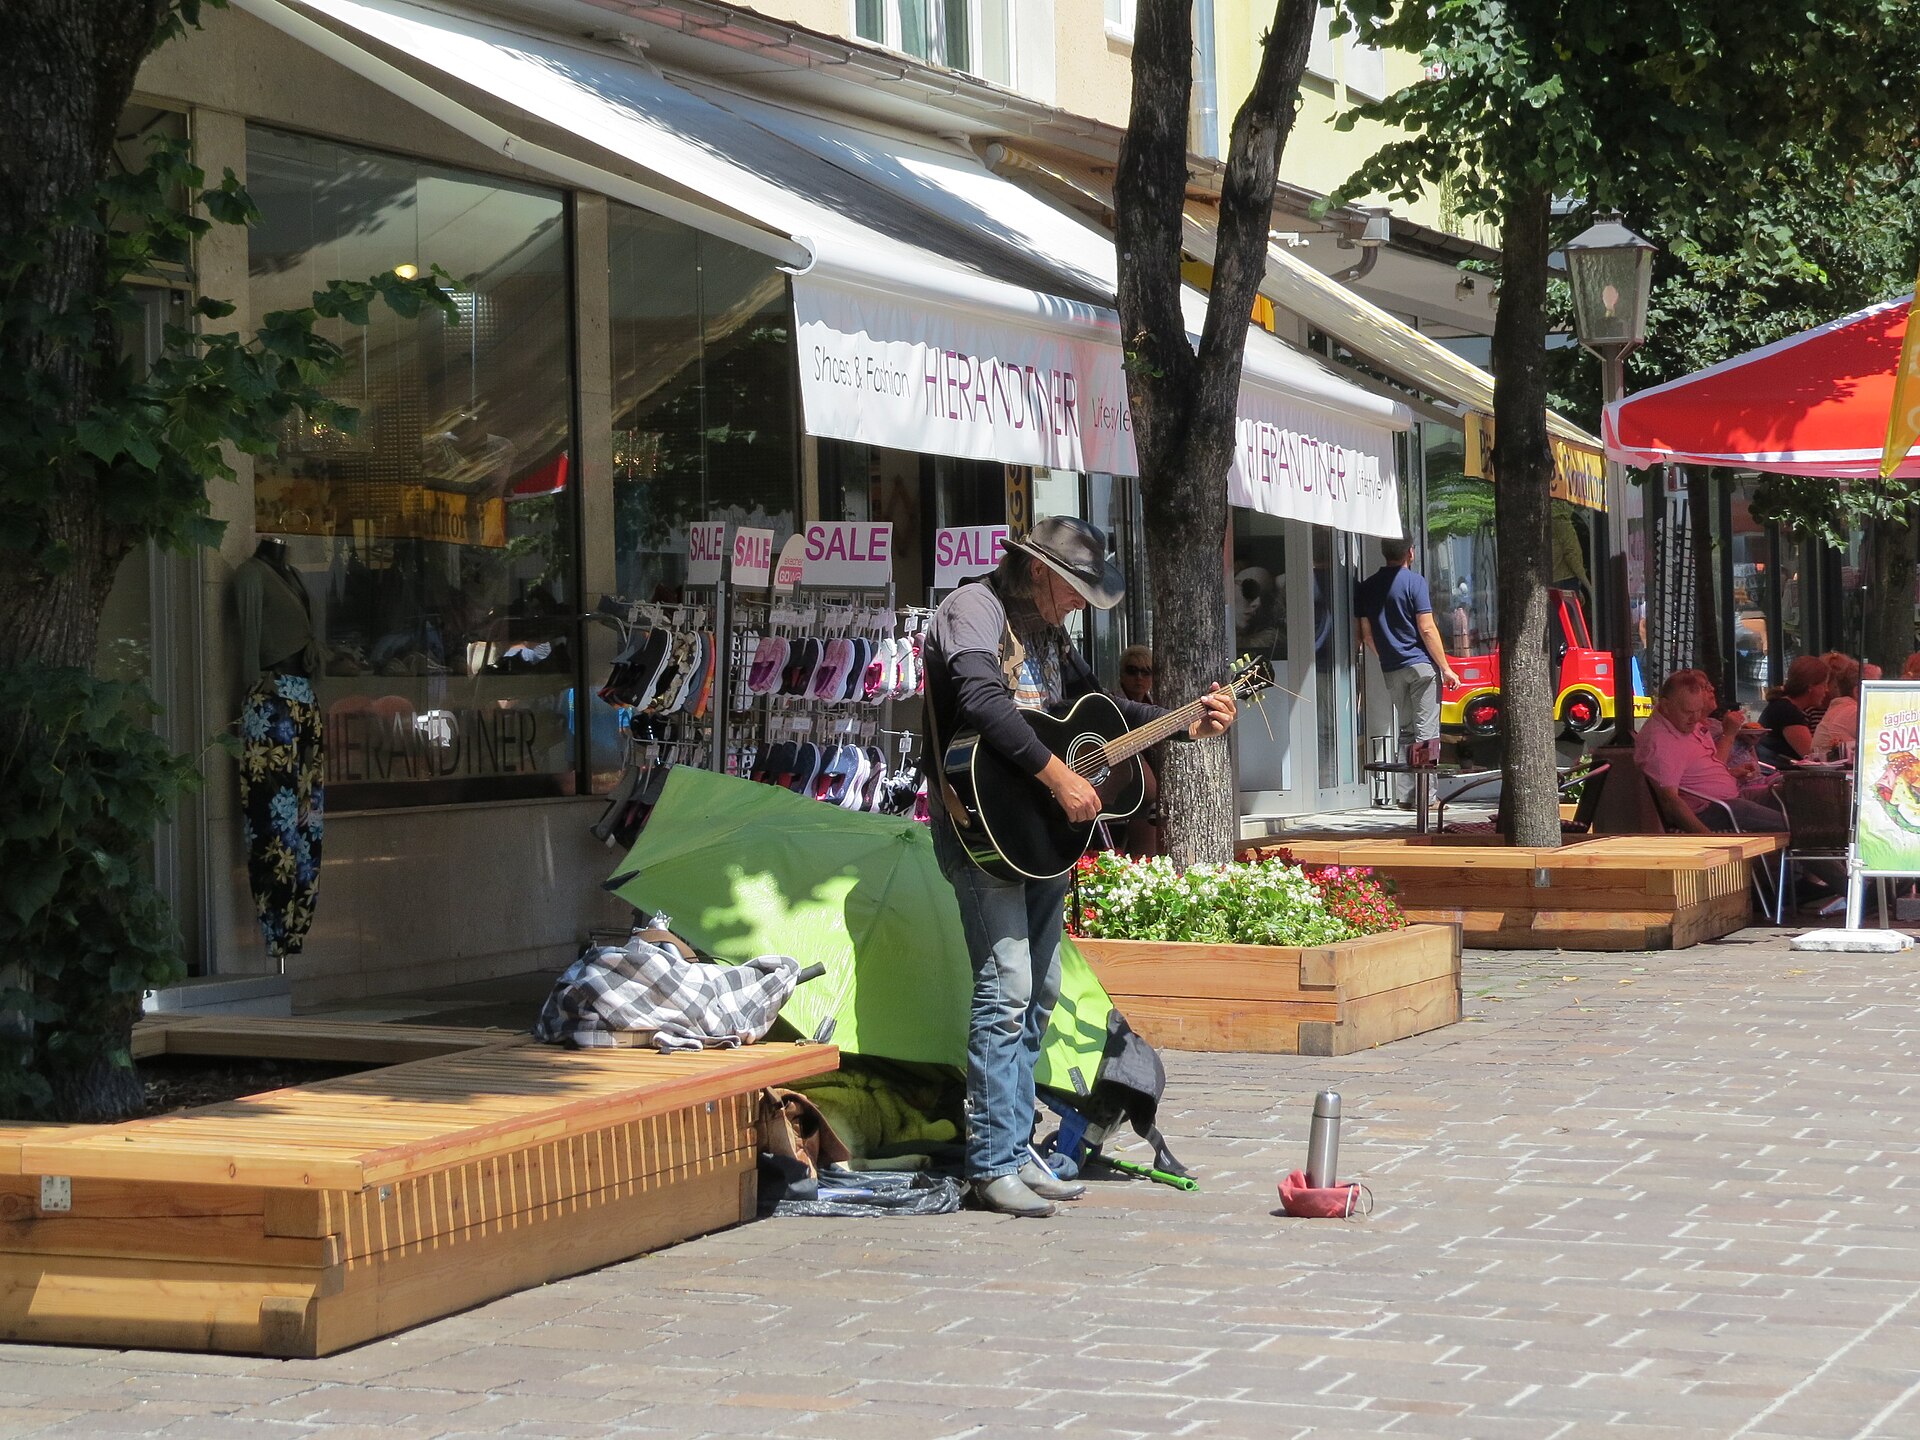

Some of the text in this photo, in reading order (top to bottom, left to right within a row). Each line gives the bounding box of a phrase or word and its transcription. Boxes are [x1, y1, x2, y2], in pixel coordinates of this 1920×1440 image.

[814, 345, 852, 384] Shoes
[855, 356, 863, 390] &
[866, 357, 910, 399] Fashion
[924, 347, 1078, 437] HIERANDINER
[1246, 421, 1347, 503] HIERANDINER
[690, 527, 723, 561] SALE
[735, 535, 771, 569] SALE
[804, 526, 889, 562] SALE
[936, 530, 1006, 567] SALE
